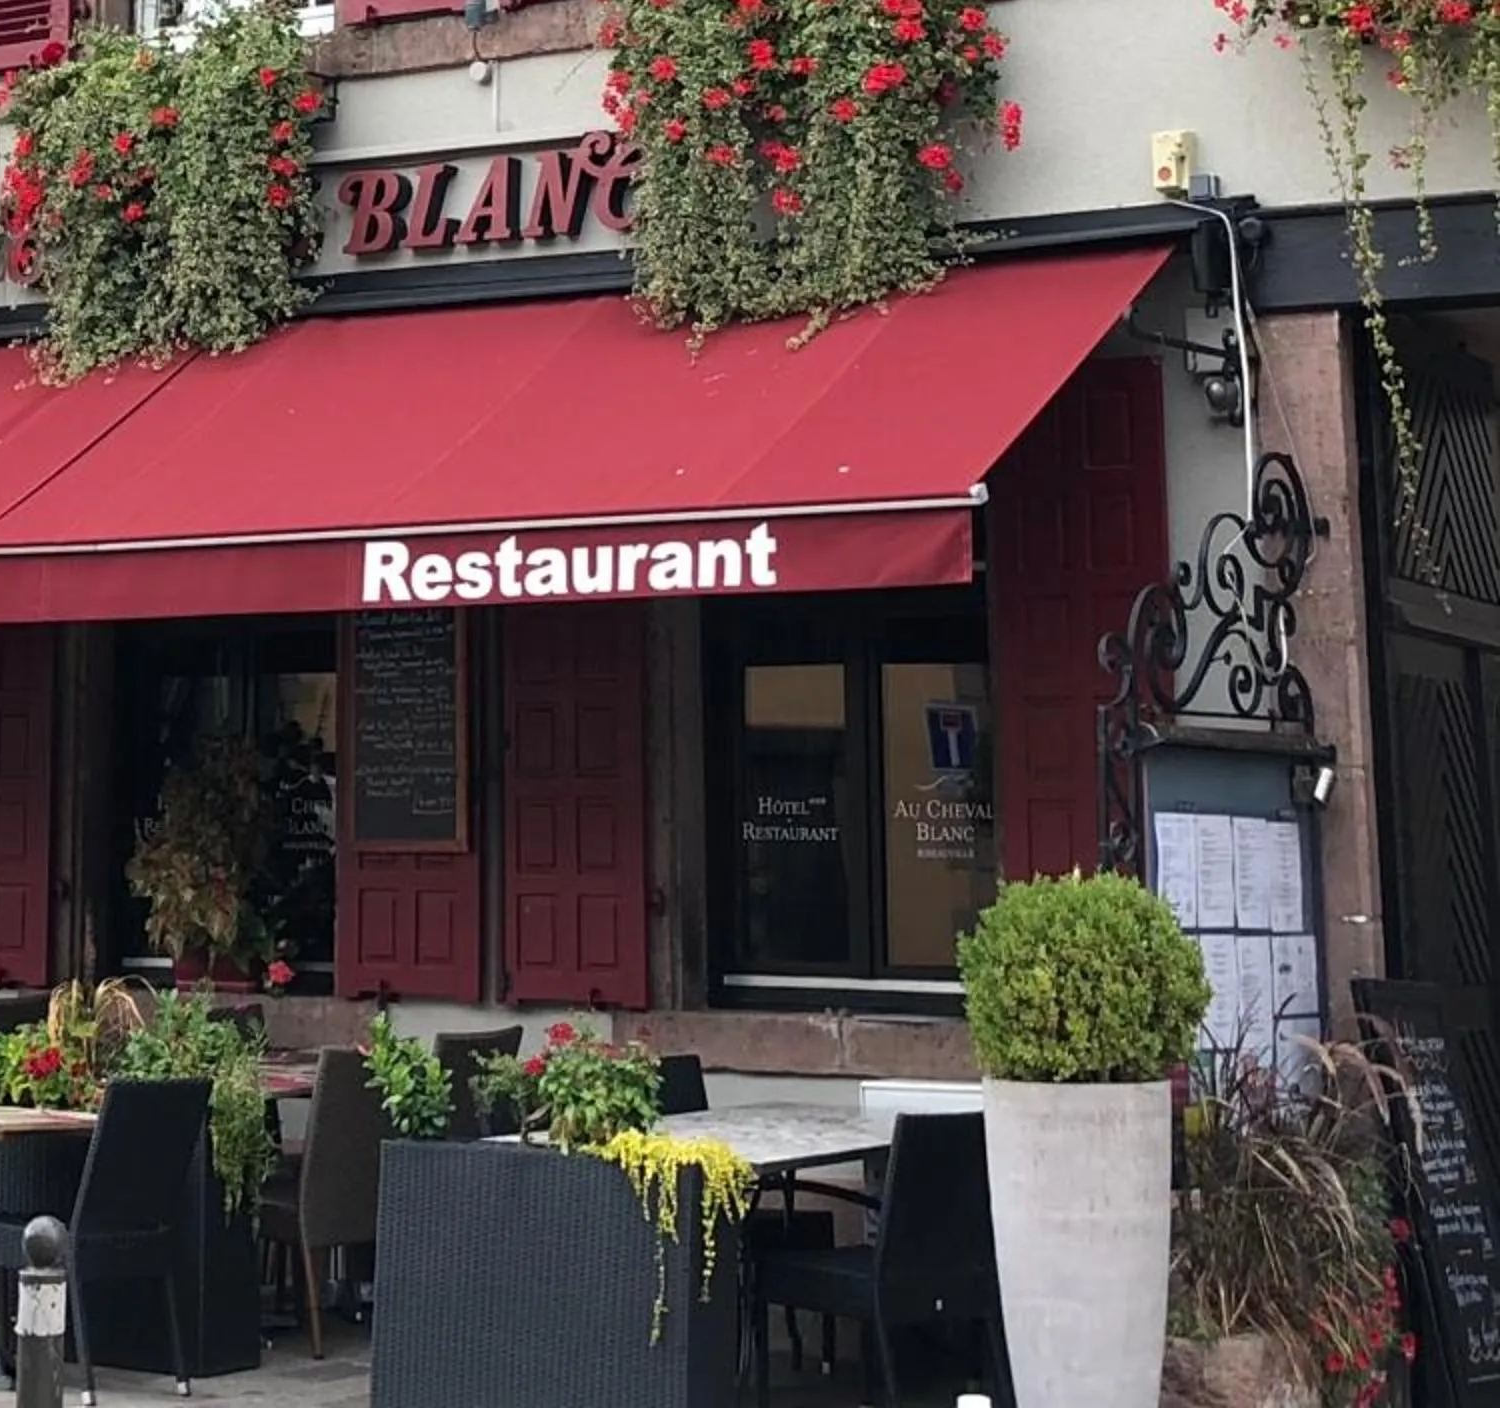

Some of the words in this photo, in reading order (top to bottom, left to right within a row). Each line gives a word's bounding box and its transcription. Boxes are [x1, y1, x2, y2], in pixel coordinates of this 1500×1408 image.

[362, 523, 777, 602] Restaurant
[894, 800, 921, 818] AU
[927, 800, 993, 819] CHEVAL
[743, 822, 839, 841] RESTAURANT
[917, 823, 975, 842] BLANC
